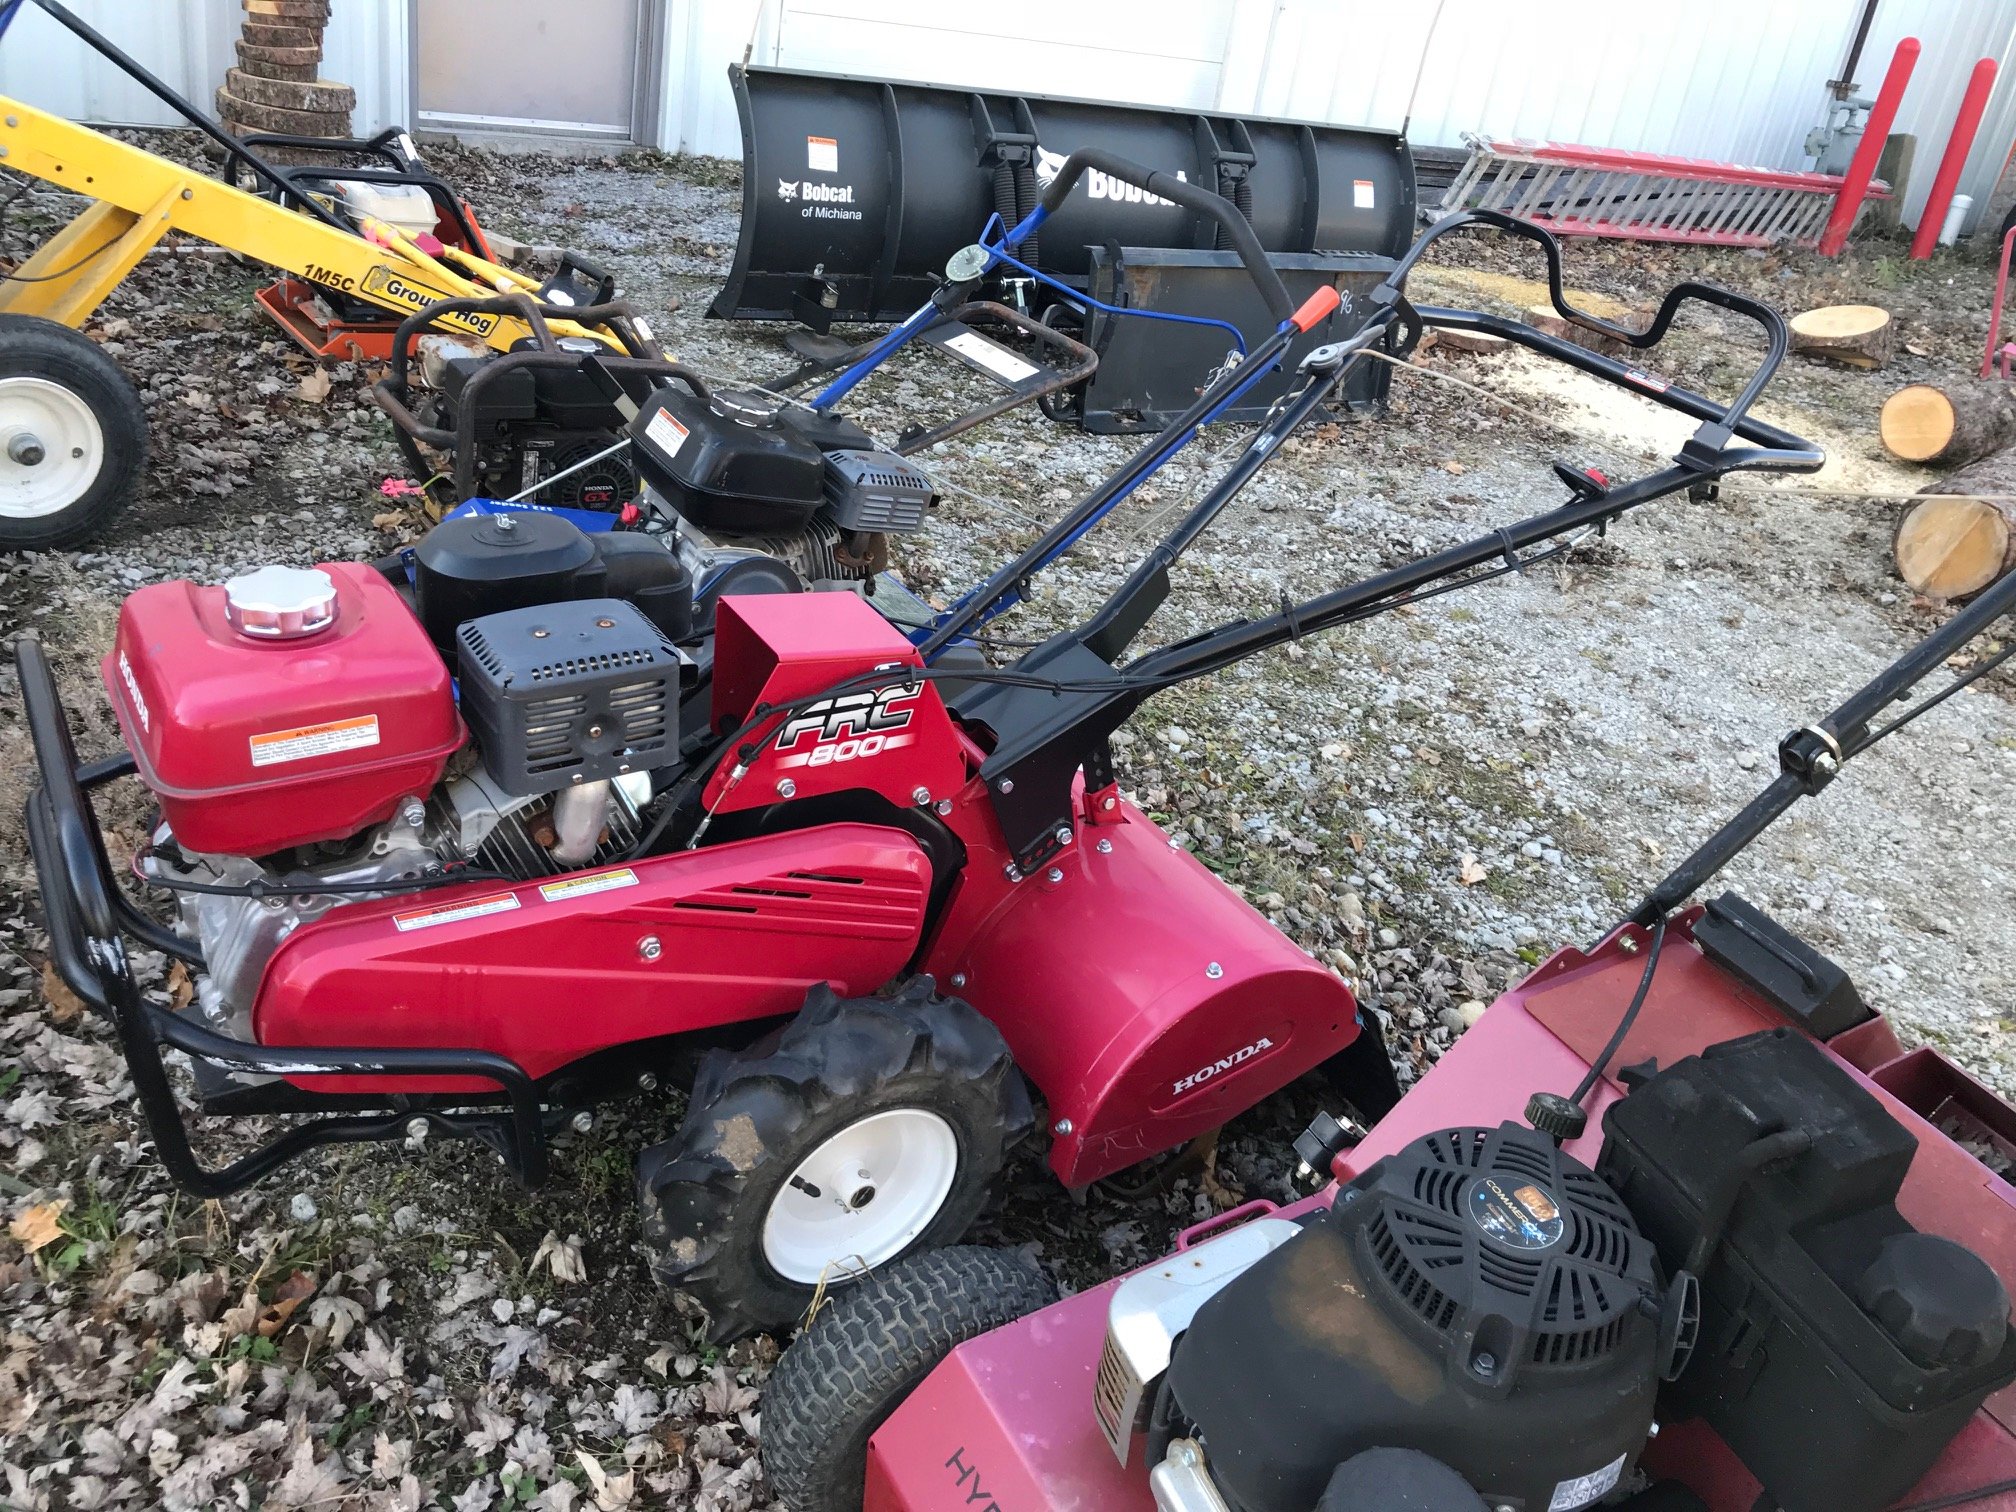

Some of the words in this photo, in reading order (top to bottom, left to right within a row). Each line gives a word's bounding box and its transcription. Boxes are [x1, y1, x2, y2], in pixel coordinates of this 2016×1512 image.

[802, 182, 853, 203] Bobcat
[801, 206, 814, 218] of
[815, 206, 862, 220] Michiana
[304, 263, 355, 292] 1M5C
[386, 279, 446, 310] Grou
[1340, 289, 1354, 315] 96
[584, 492, 612, 503] GX
[118, 649, 150, 734] HONDA
[775, 680, 925, 750] FRC
[304, 725, 336, 736] WARNING
[808, 735, 887, 768] 800
[573, 874, 608, 887] CAUTION
[1173, 1037, 1274, 1096] HONDA
